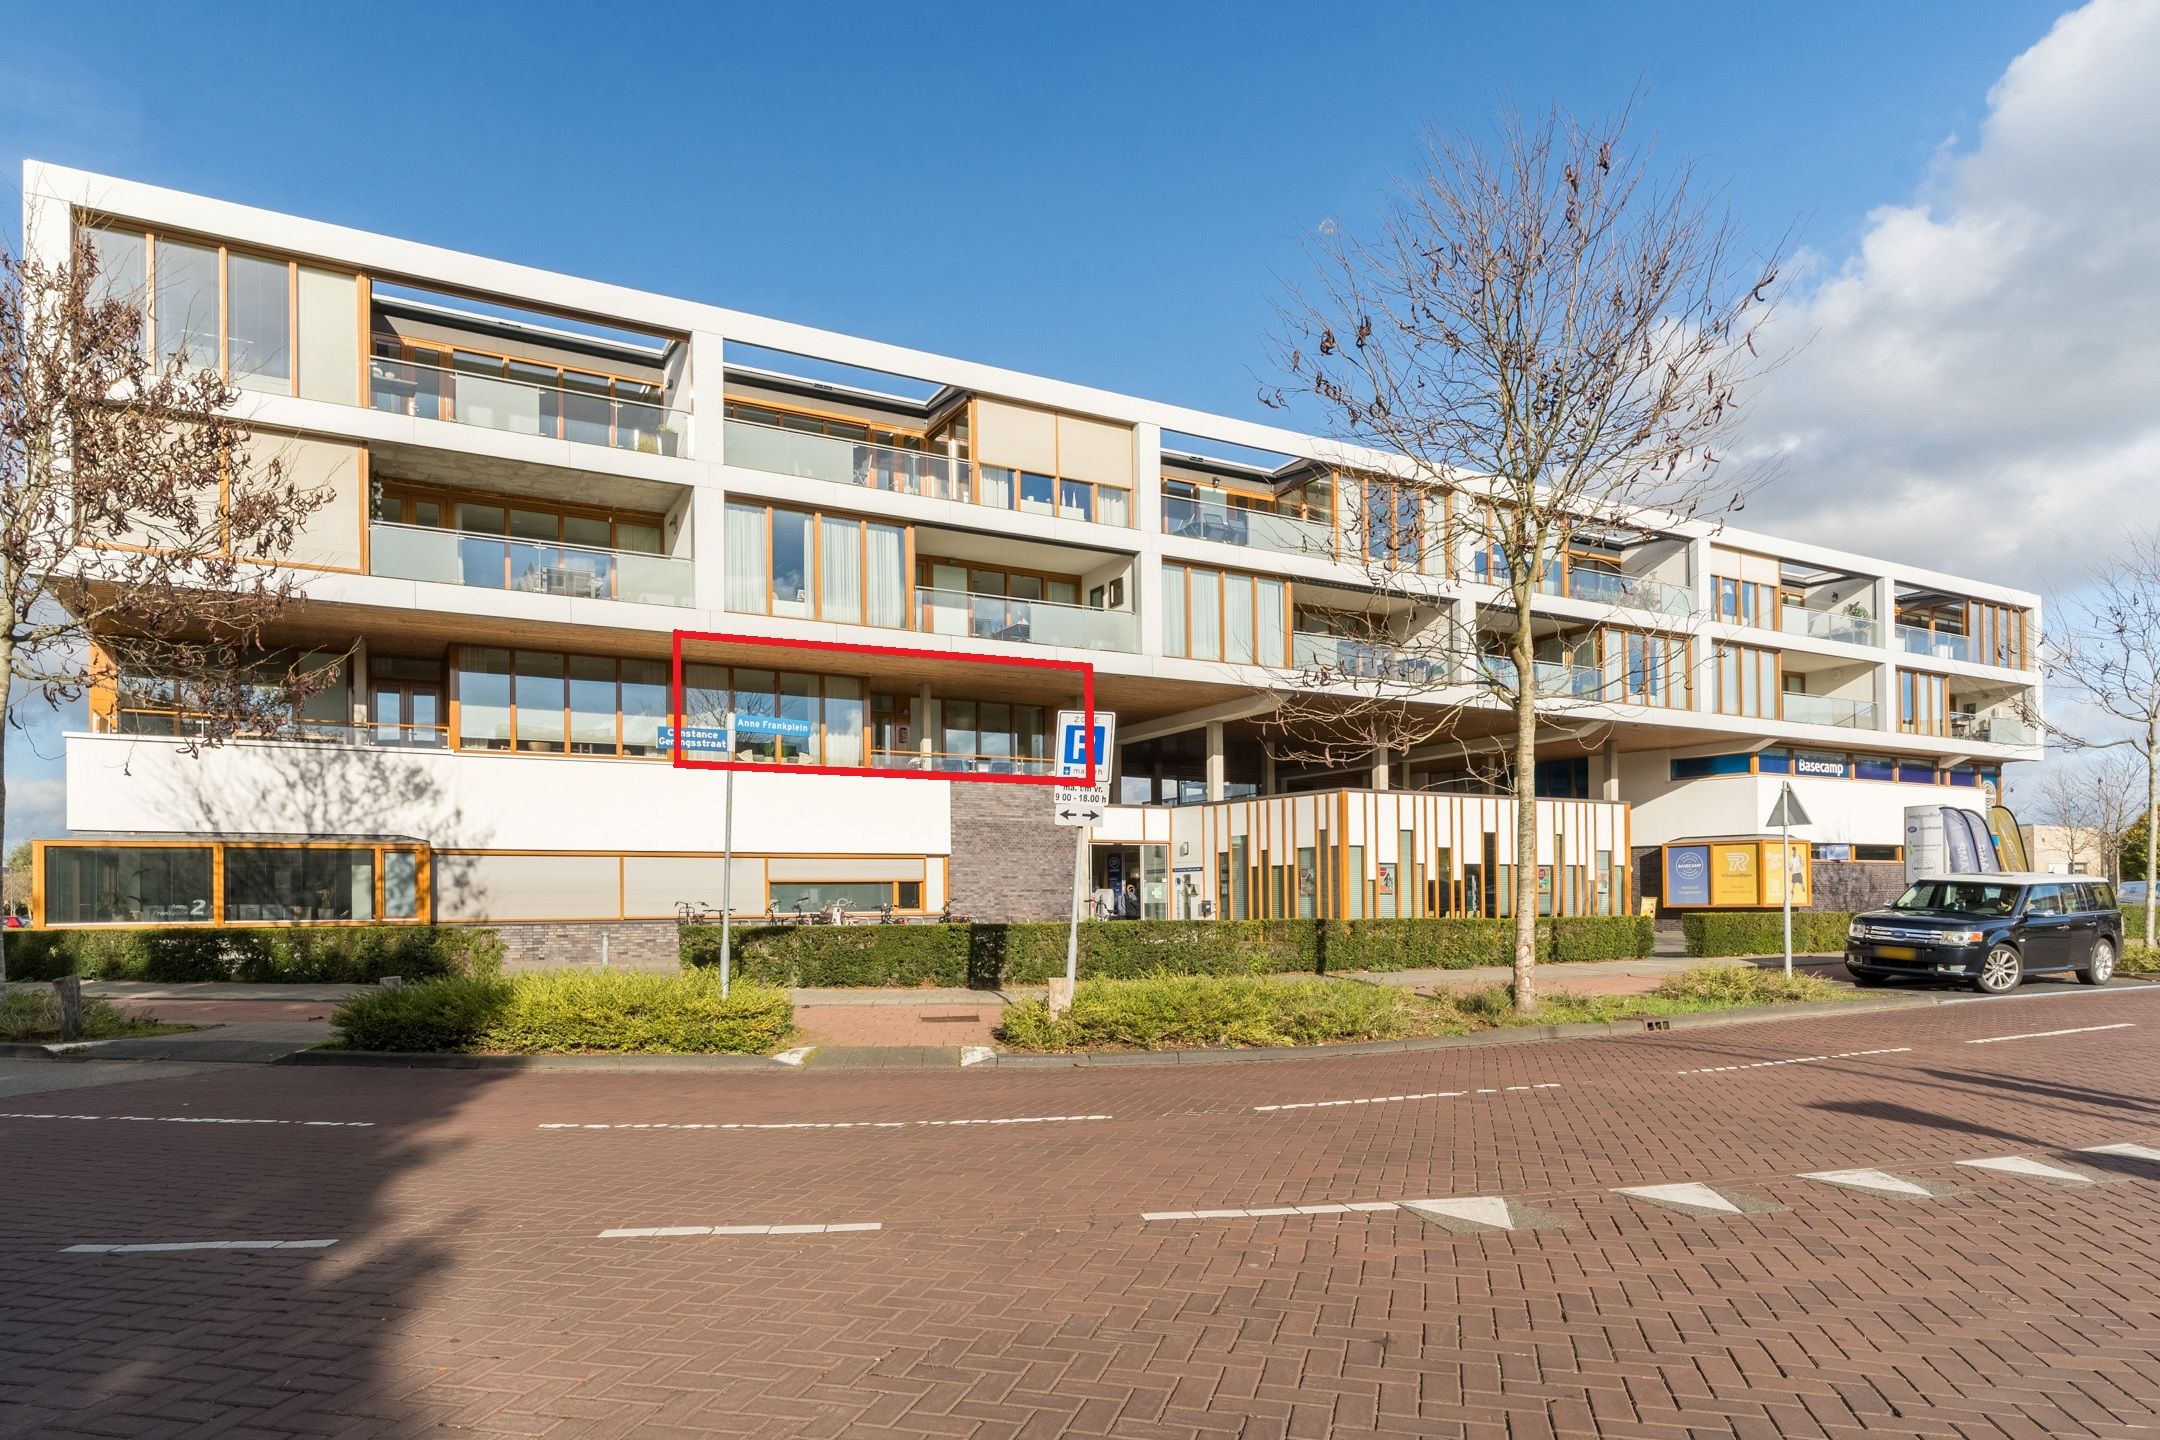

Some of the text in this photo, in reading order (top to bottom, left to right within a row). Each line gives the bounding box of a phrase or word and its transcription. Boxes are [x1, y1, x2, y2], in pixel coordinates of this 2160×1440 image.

[737, 718, 808, 732] Anne Frankplein
[1074, 716, 1100, 724] ZOE
[667, 728, 718, 739] Cnstance
[1799, 759, 1843, 776] Basecamp
[1079, 794, 1099, 803] 18.00
[1101, 795, 1107, 803] h
[190, 899, 206, 915] 2
